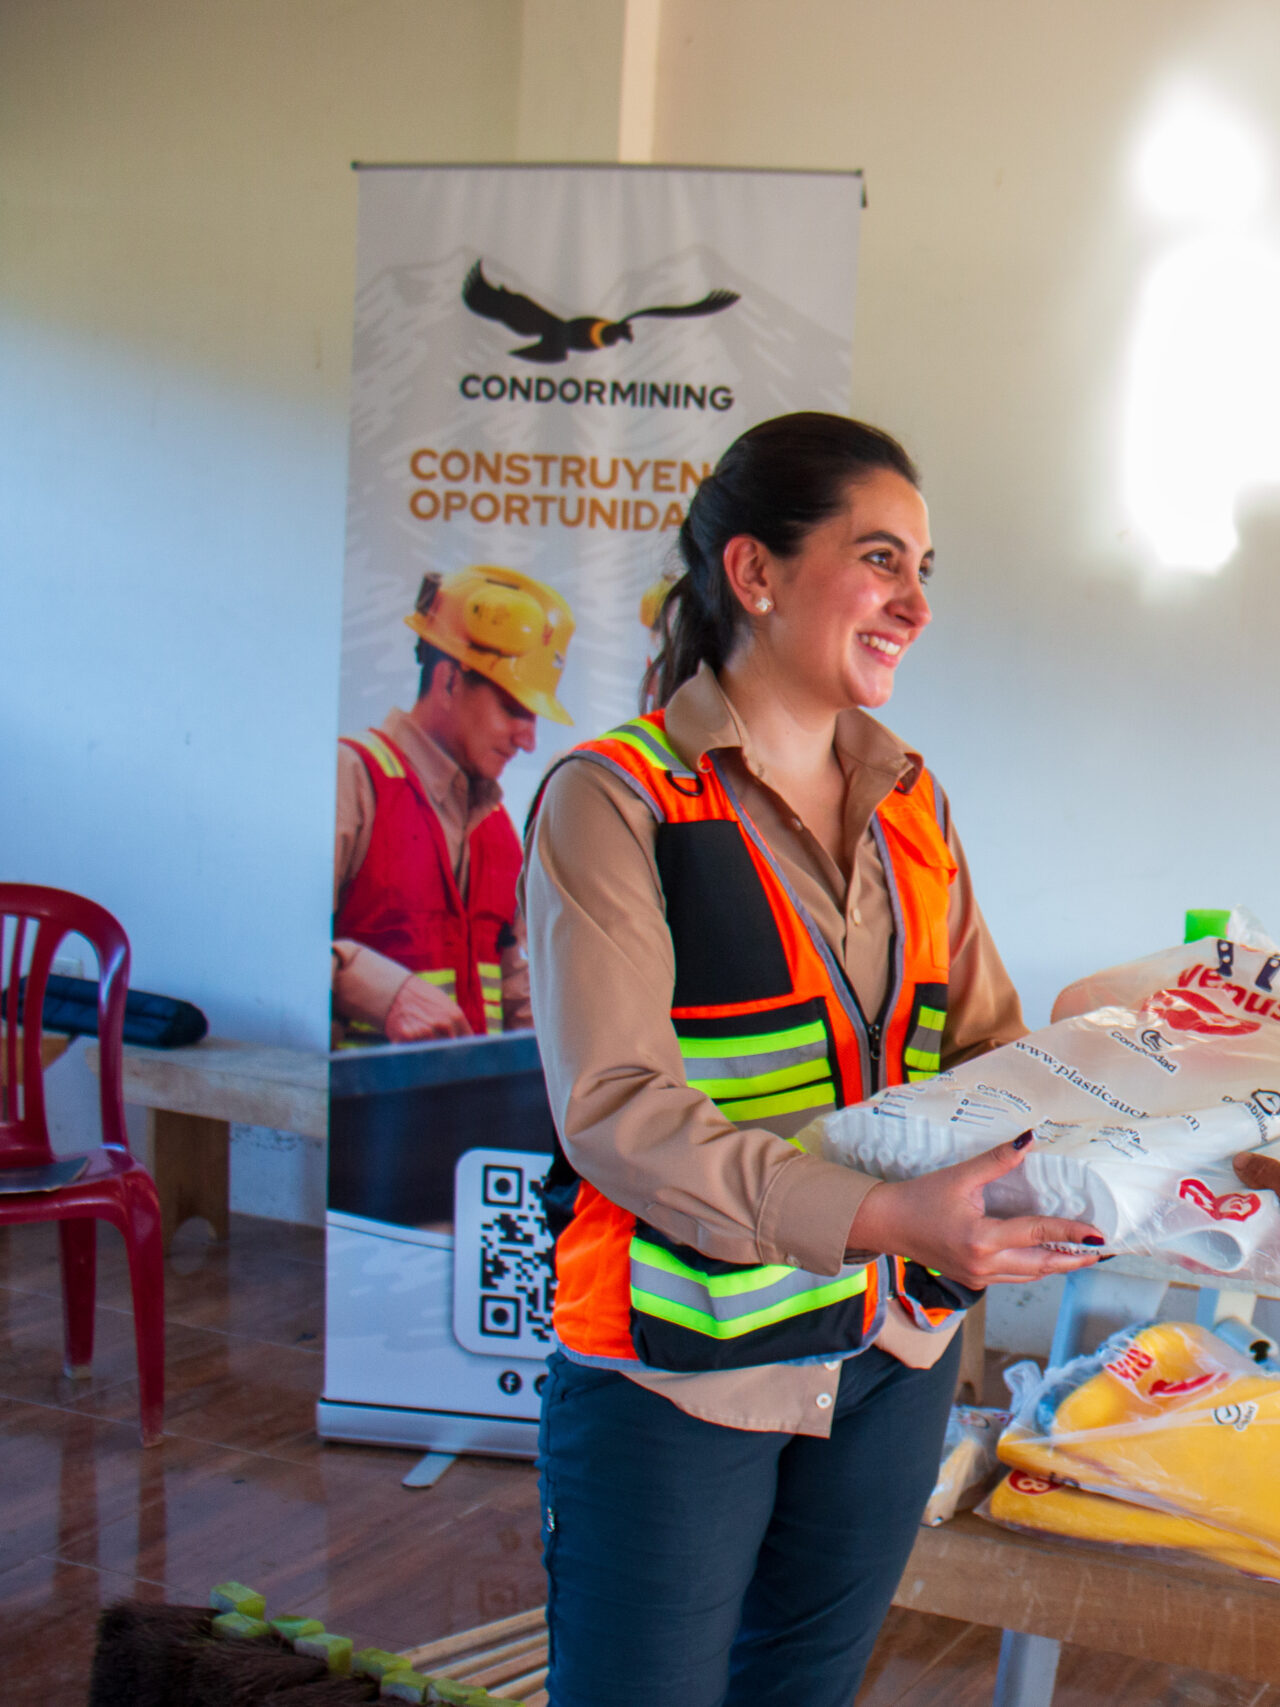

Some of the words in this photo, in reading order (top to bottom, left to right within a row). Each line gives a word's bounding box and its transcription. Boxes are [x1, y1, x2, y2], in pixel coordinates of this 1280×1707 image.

[460, 374, 734, 411] CONDORMINING
[410, 448, 711, 494] CONSTRUYEN
[409, 490, 684, 532] OPORTUNIDA
